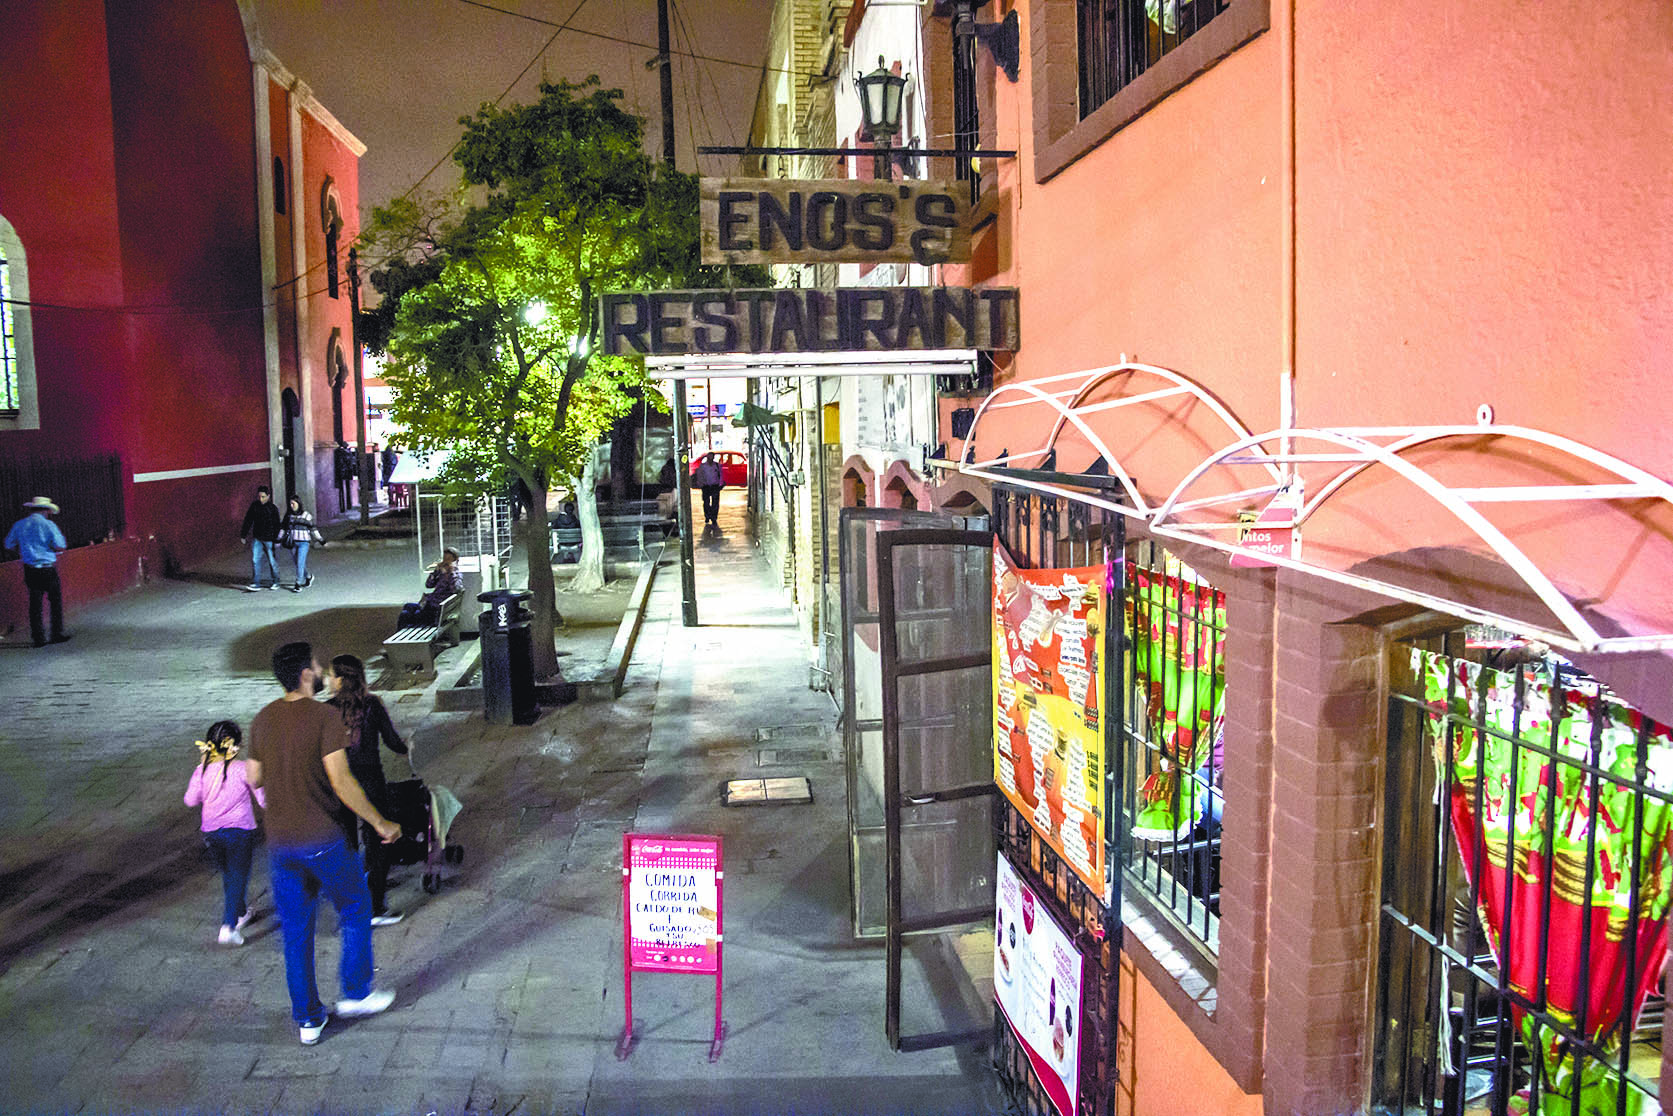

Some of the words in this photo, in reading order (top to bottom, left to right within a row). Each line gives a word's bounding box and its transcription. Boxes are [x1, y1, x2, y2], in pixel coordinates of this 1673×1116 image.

[604, 289, 1017, 353] RESTAURANT
[645, 873, 696, 887] COMIDA
[650, 889, 698, 902] CORRIDA
